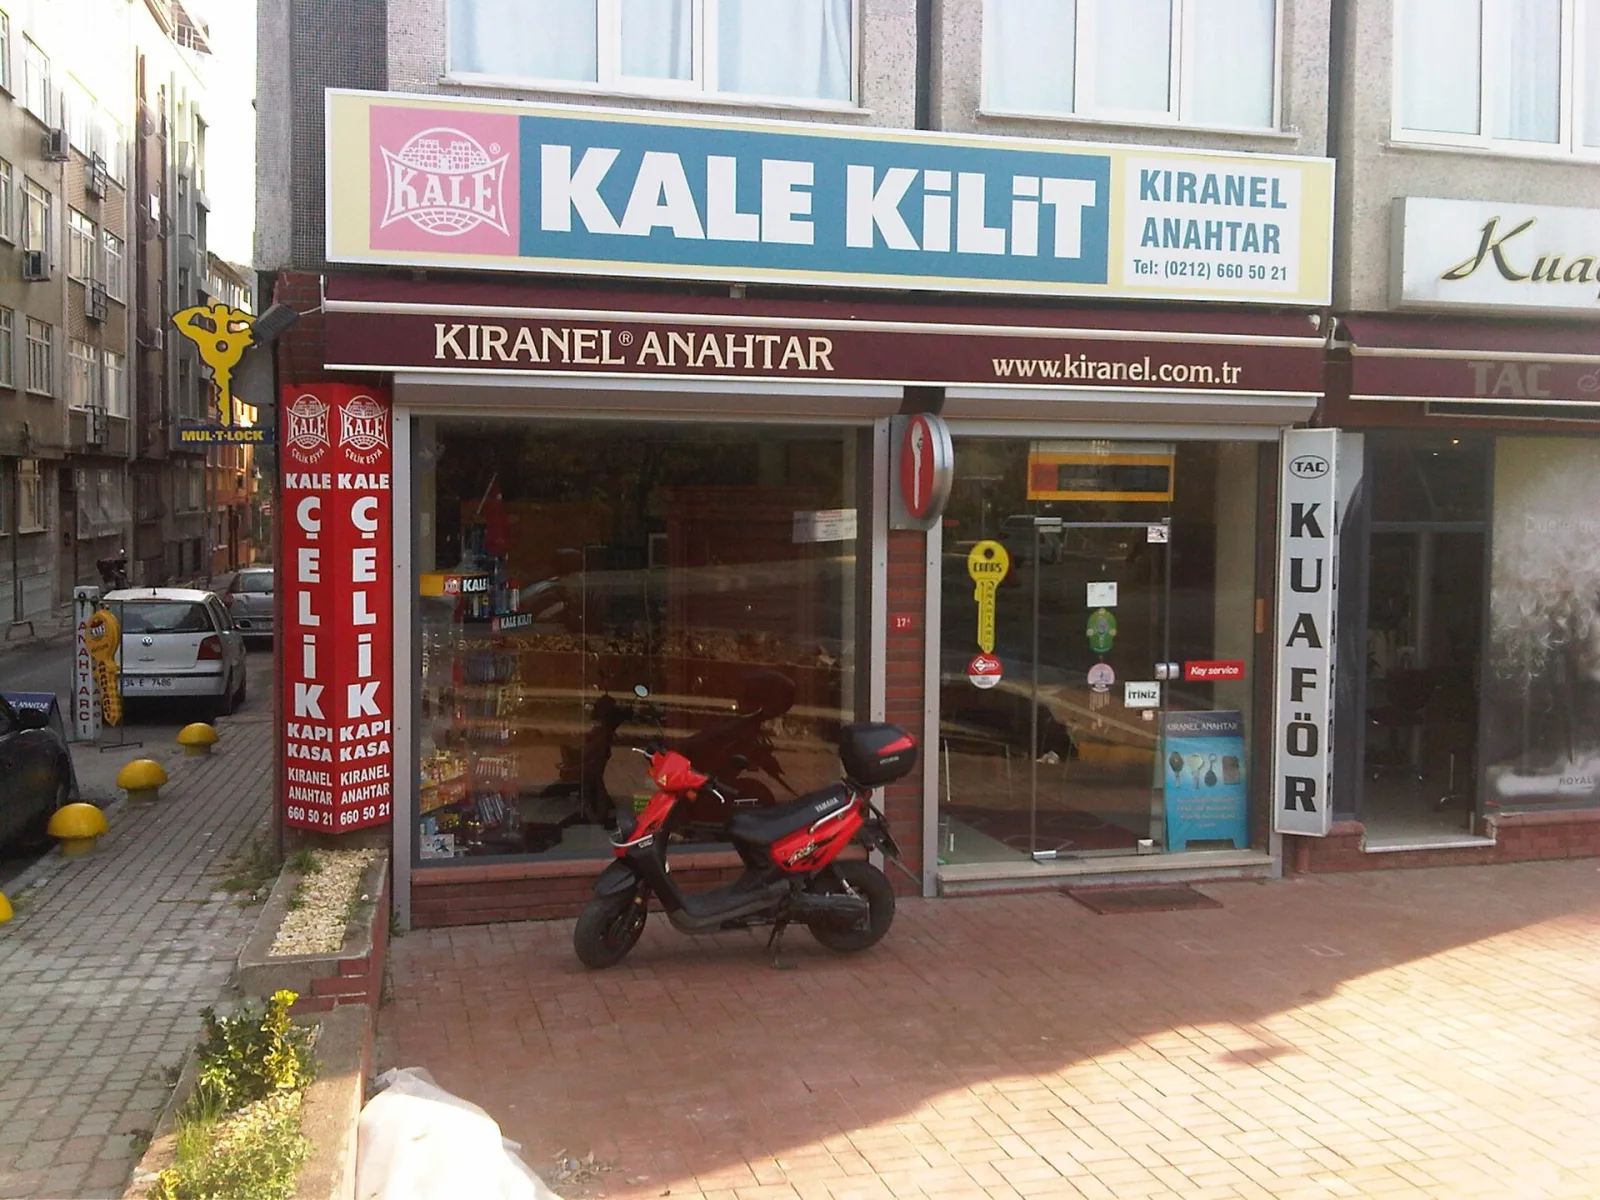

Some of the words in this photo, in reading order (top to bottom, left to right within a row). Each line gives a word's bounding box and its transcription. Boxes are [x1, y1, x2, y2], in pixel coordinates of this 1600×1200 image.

[393, 159, 497, 217] KALE
[541, 144, 815, 246] KALE
[1140, 169, 1287, 209] KIRANEL
[1140, 216, 1280, 254] ANAHTAR
[1133, 259, 1159, 275] Tel:
[1164, 260, 1211, 280] (0212)
[1217, 263, 1243, 279] 660
[1248, 265, 1266, 280] 50
[1271, 266, 1287, 280] 21
[637, 330, 834, 371] ANAHTAR
[992, 354, 1242, 385] www.kiranel.com.tr
[1467, 361, 1551, 397] TAC
[290, 411, 326, 440] KALE
[343, 411, 384, 440] KALE
[1294, 461, 1326, 473] TAC
[286, 473, 331, 490] KALE
[338, 473, 390, 490] KALE
[1284, 502, 1325, 813] KUAFÖR
[1190, 666, 1207, 677] Key
[287, 722, 333, 743] KAPI
[340, 719, 391, 742] KAPI
[287, 742, 333, 763] KASA
[340, 740, 390, 762] KASA
[287, 766, 333, 787] KIRANEL
[340, 764, 390, 787] KIRANEL
[1559, 776, 1592, 785] ROYAL
[288, 786, 333, 805] ANAHTAR
[340, 782, 390, 805] ANAHTAR
[287, 805, 305, 820] 660
[307, 809, 319, 823] 50
[322, 812, 333, 826] 21
[340, 809, 359, 826] 660
[362, 805, 376, 820] 50
[378, 802, 390, 817] 21
